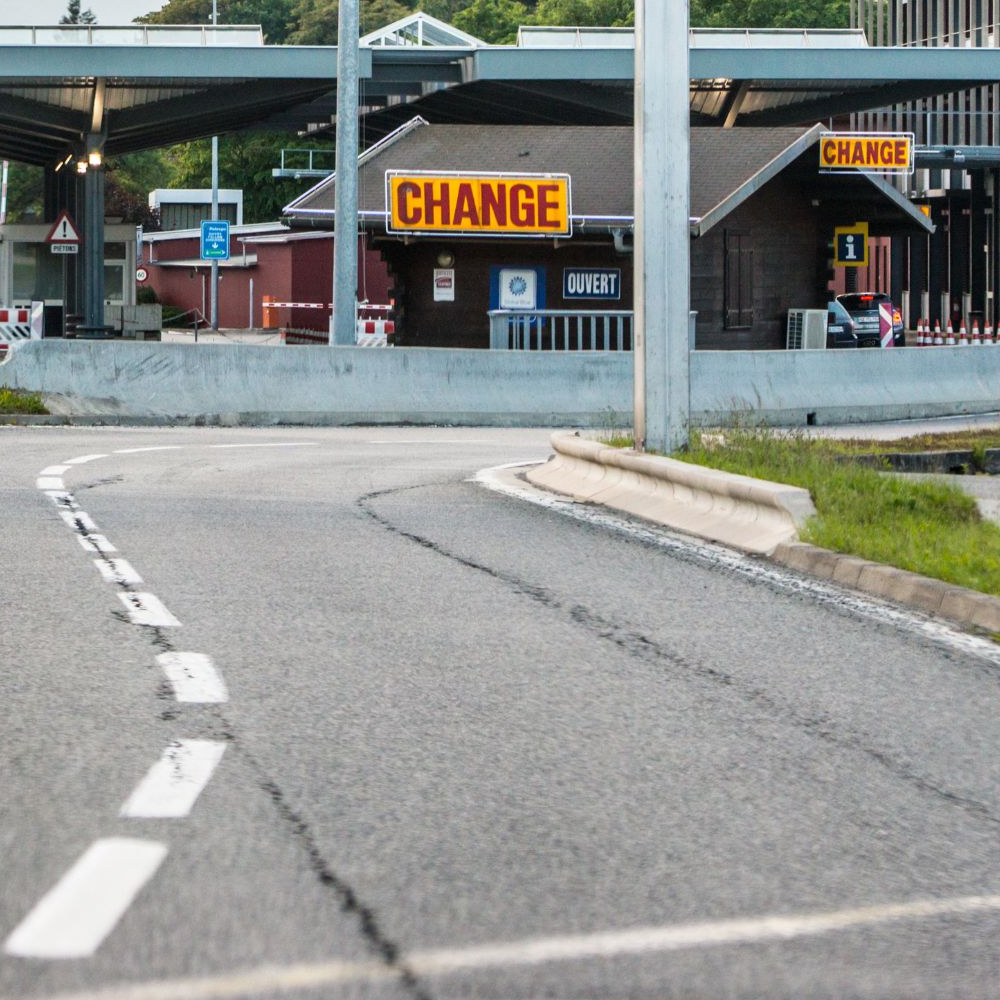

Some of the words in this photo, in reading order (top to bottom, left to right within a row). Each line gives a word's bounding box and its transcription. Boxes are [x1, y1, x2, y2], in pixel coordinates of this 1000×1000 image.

[823, 140, 906, 165] CHANGE
[397, 181, 561, 228] CHANGE
[568, 272, 617, 295] OUVERT
